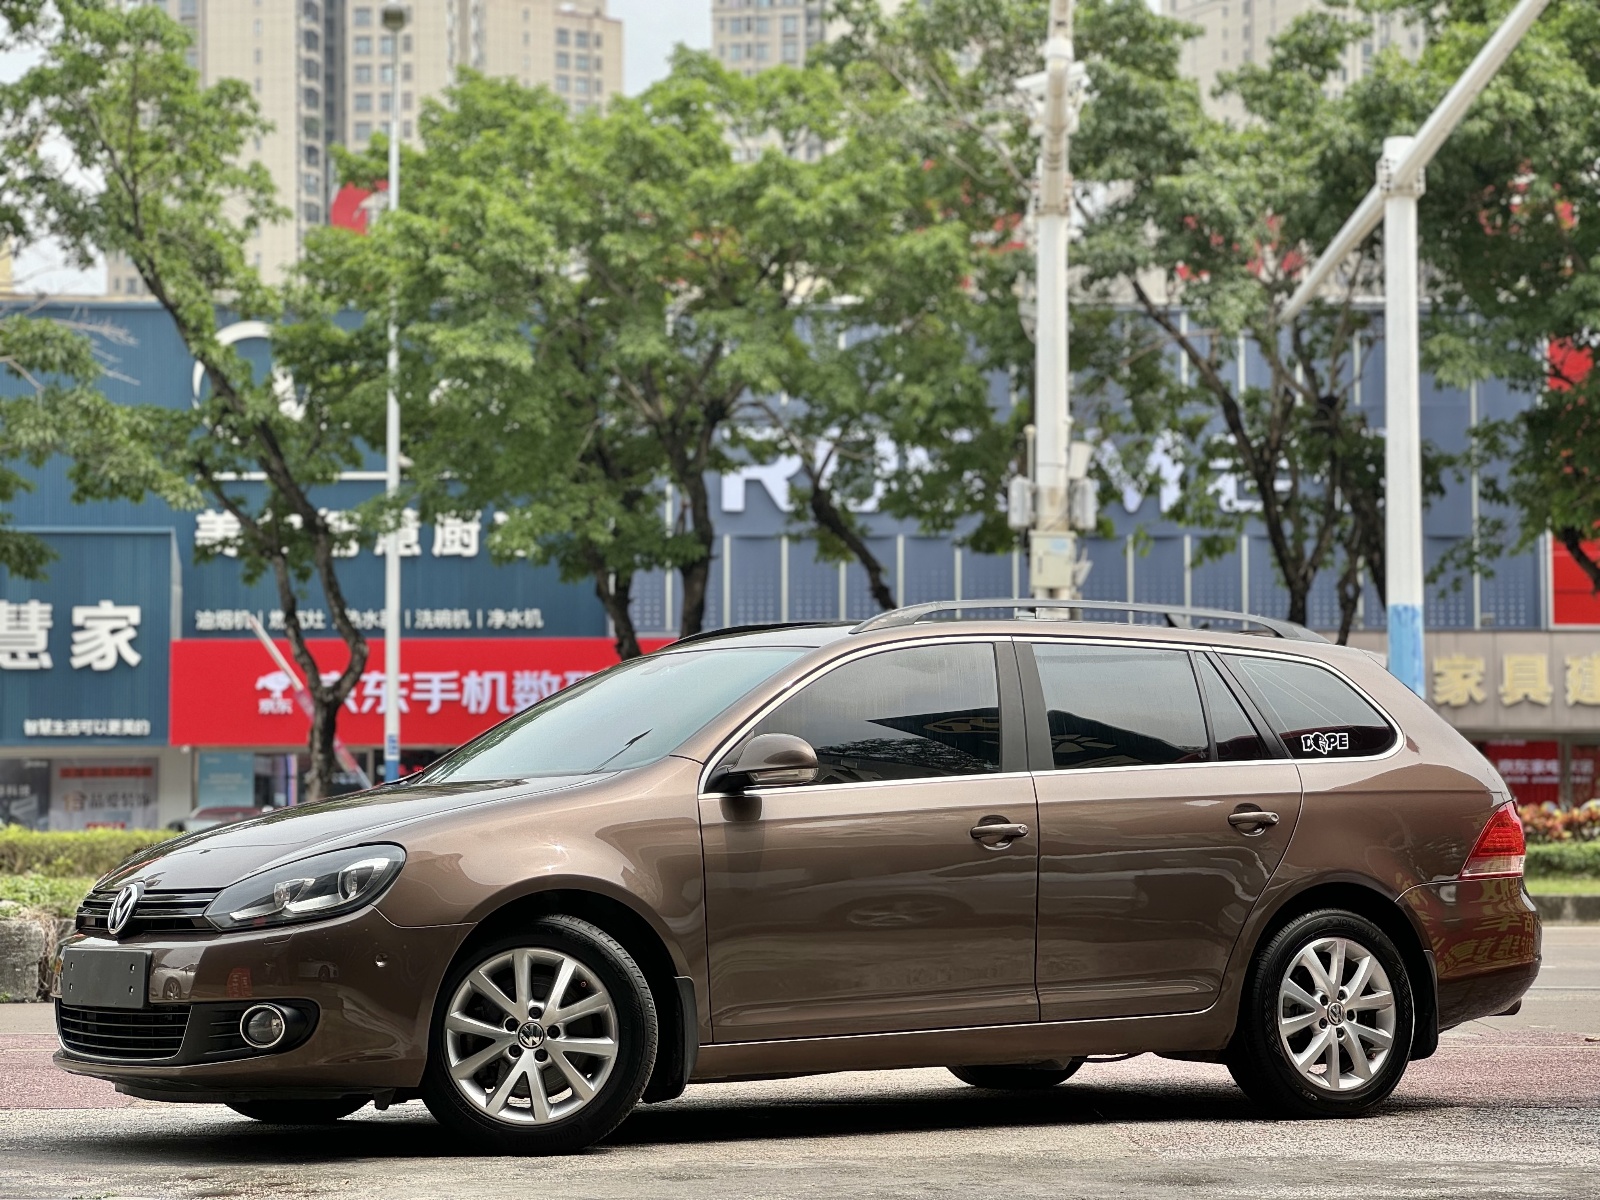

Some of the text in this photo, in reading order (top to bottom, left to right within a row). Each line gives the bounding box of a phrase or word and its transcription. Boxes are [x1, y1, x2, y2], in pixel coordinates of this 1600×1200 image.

[195, 609, 253, 631] 油烟机
[414, 608, 472, 629] 洗碗机
[487, 608, 544, 629] 净水机
[0, 599, 142, 671] 慧家
[258, 698, 293, 715] 京东
